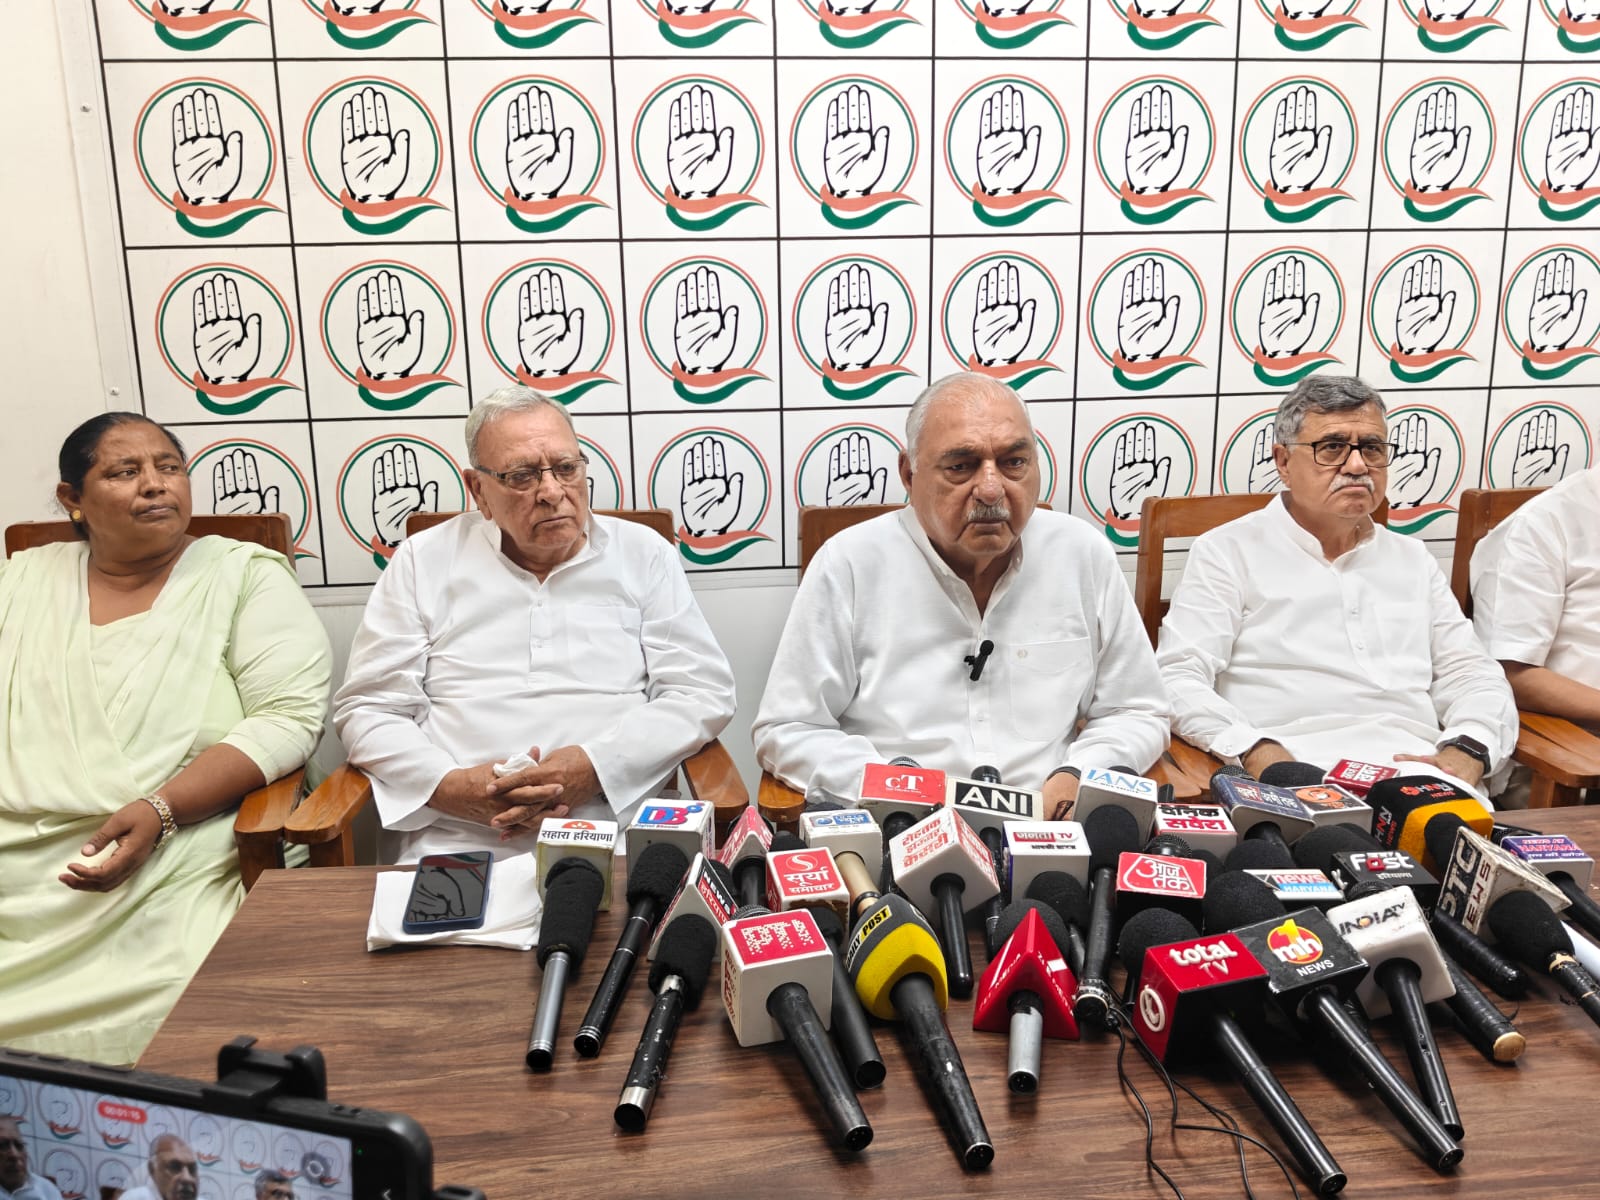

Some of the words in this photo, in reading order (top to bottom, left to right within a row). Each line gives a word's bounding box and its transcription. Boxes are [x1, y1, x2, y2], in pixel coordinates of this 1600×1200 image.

[1086, 769, 1154, 794] IANS
[959, 786, 1028, 815] ANI
[1162, 815, 1227, 830] सवेरा
[541, 830, 570, 841] सहारा
[573, 829, 614, 842] हरियाणा
[1135, 860, 1181, 878] आज
[703, 871, 731, 915] NEWS
[788, 882, 834, 894] समाचार
[1151, 875, 1191, 891] तक
[1466, 860, 1491, 926] EWS
[862, 908, 889, 936] POST
[1339, 907, 1401, 936] INDIA
[1391, 902, 1407, 914] TV
[741, 918, 815, 956] PTI
[1169, 940, 1238, 967] total
[1198, 959, 1229, 979] TV
[1296, 959, 1335, 977] NEWS
